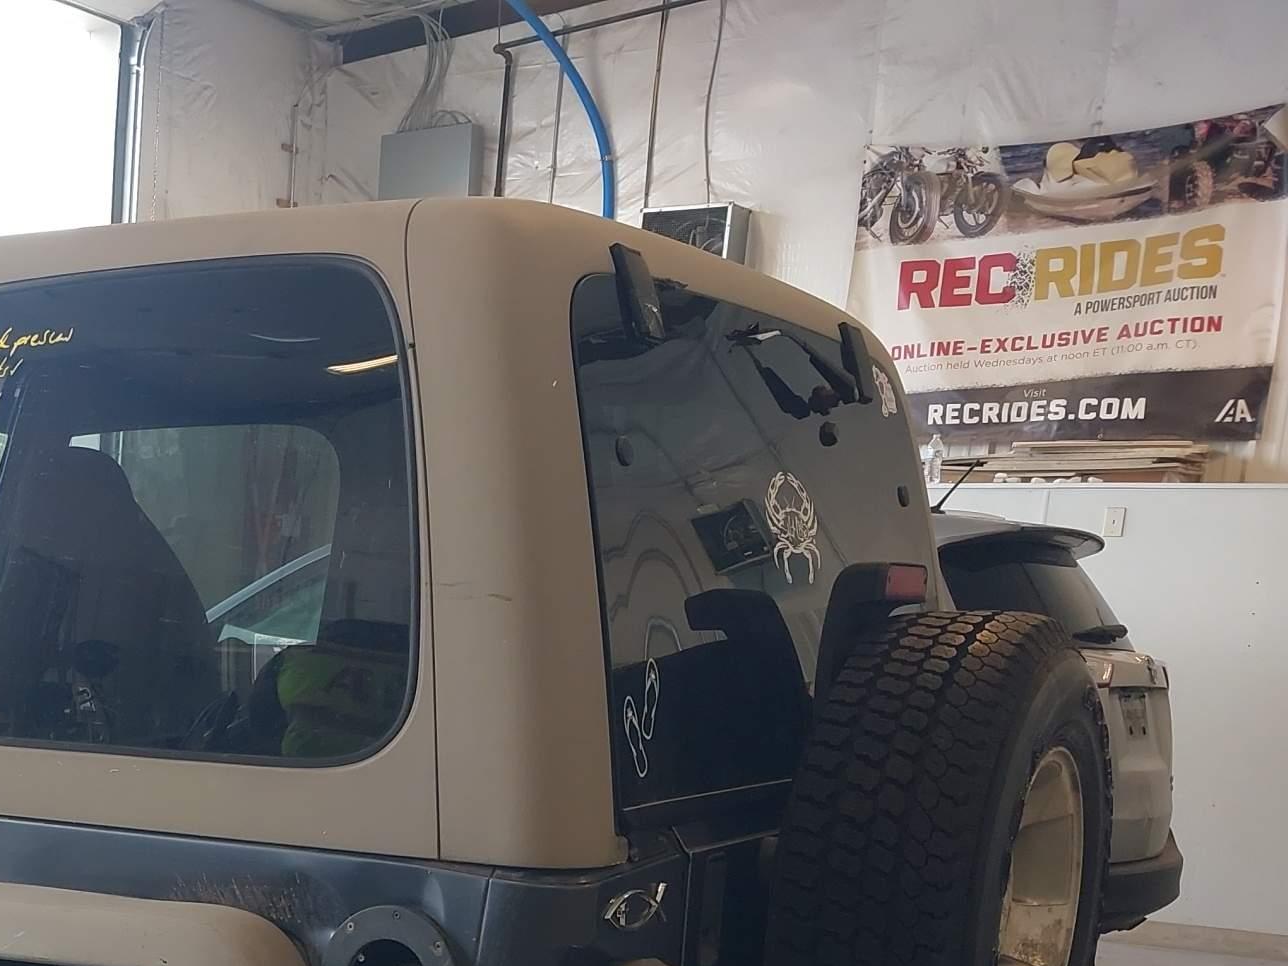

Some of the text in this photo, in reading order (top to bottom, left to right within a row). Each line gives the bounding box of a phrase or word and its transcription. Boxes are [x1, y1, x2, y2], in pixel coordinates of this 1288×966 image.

[897, 223, 1226, 311] REC RIDES
[1073, 284, 1218, 316] A POWERSPORT AUCTION
[891, 315, 1223, 361] ONLINE-EXCLUSIVE AUCTION
[905, 360, 943, 374] Auction
[945, 358, 969, 370] held
[973, 350, 1043, 369] Wednesdays
[1047, 352, 1057, 363] at
[1061, 350, 1089, 361] noon
[1093, 347, 1107, 358] ET
[1022, 388, 1047, 399] Visit
[927, 397, 1147, 426] RECRIDES.COM
